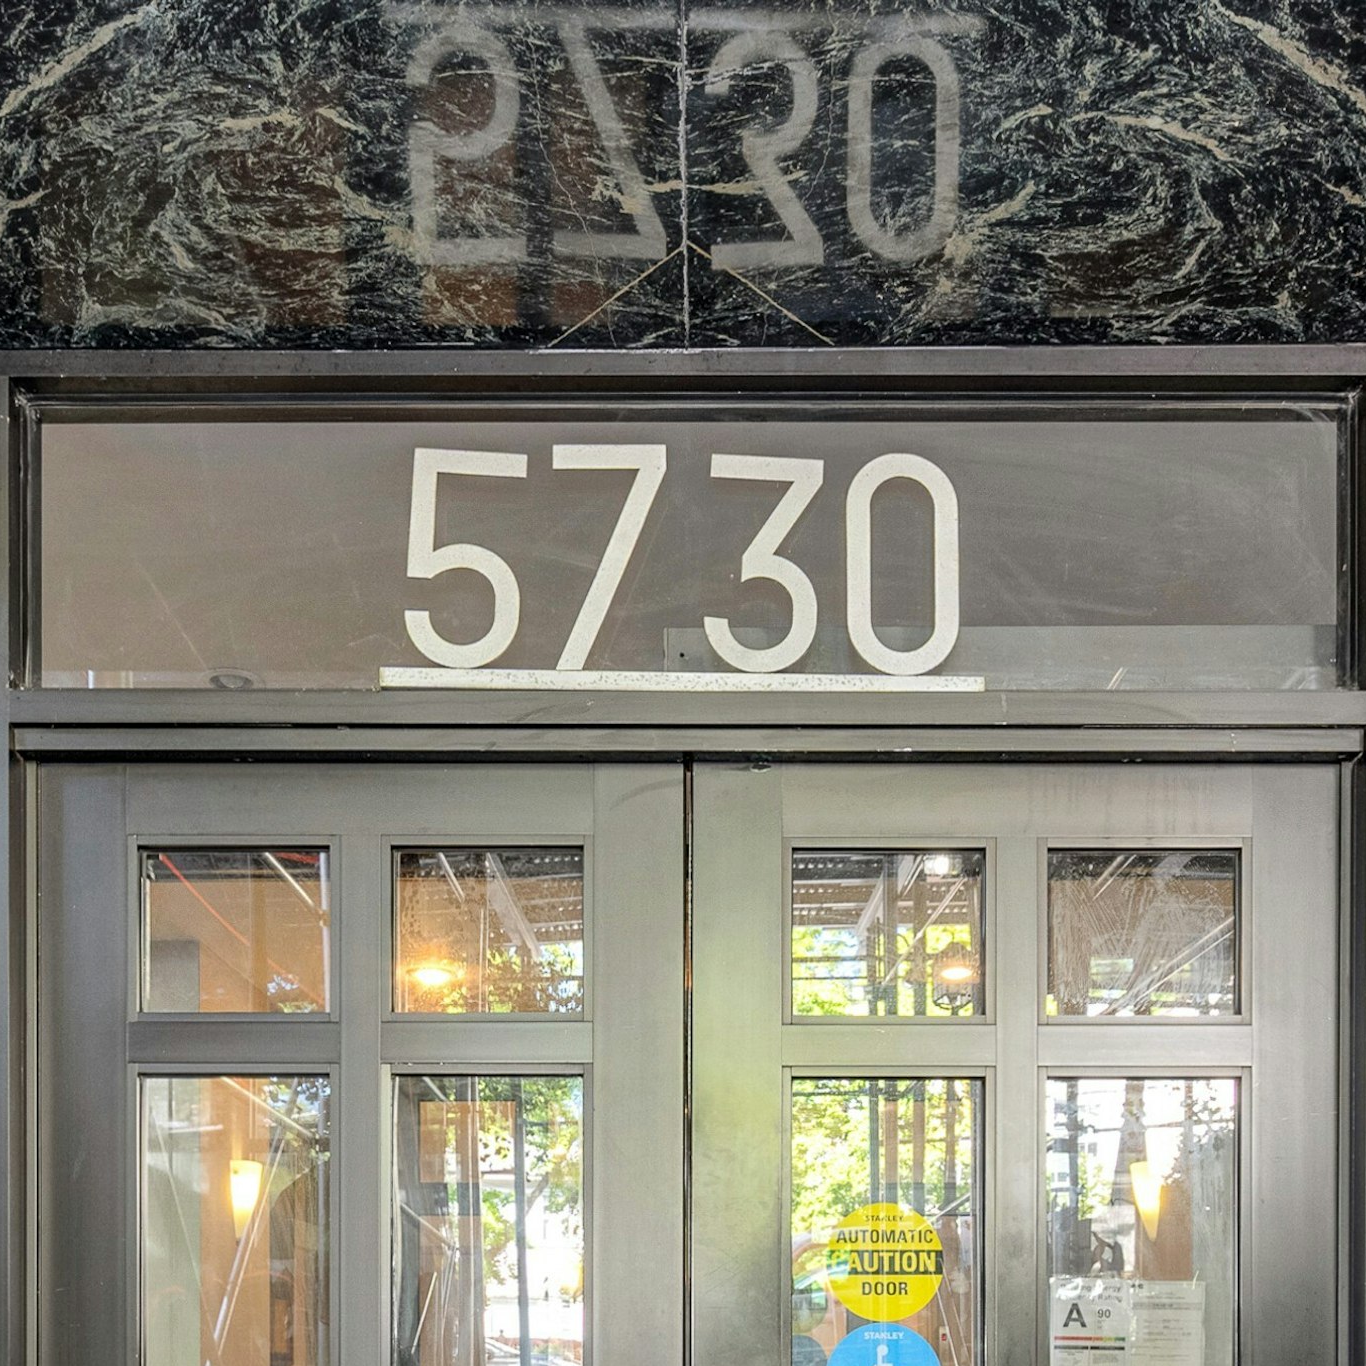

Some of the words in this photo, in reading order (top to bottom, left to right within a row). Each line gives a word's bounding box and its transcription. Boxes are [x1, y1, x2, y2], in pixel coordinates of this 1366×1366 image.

[403, 444, 960, 677] 5730
[836, 1229, 933, 1243] AUTOMATIC
[862, 1282, 908, 1296] DOOR
[1063, 1302, 1087, 1328] A
[1097, 1308, 1111, 1319] 90
[864, 1331, 905, 1340] STANLEY
